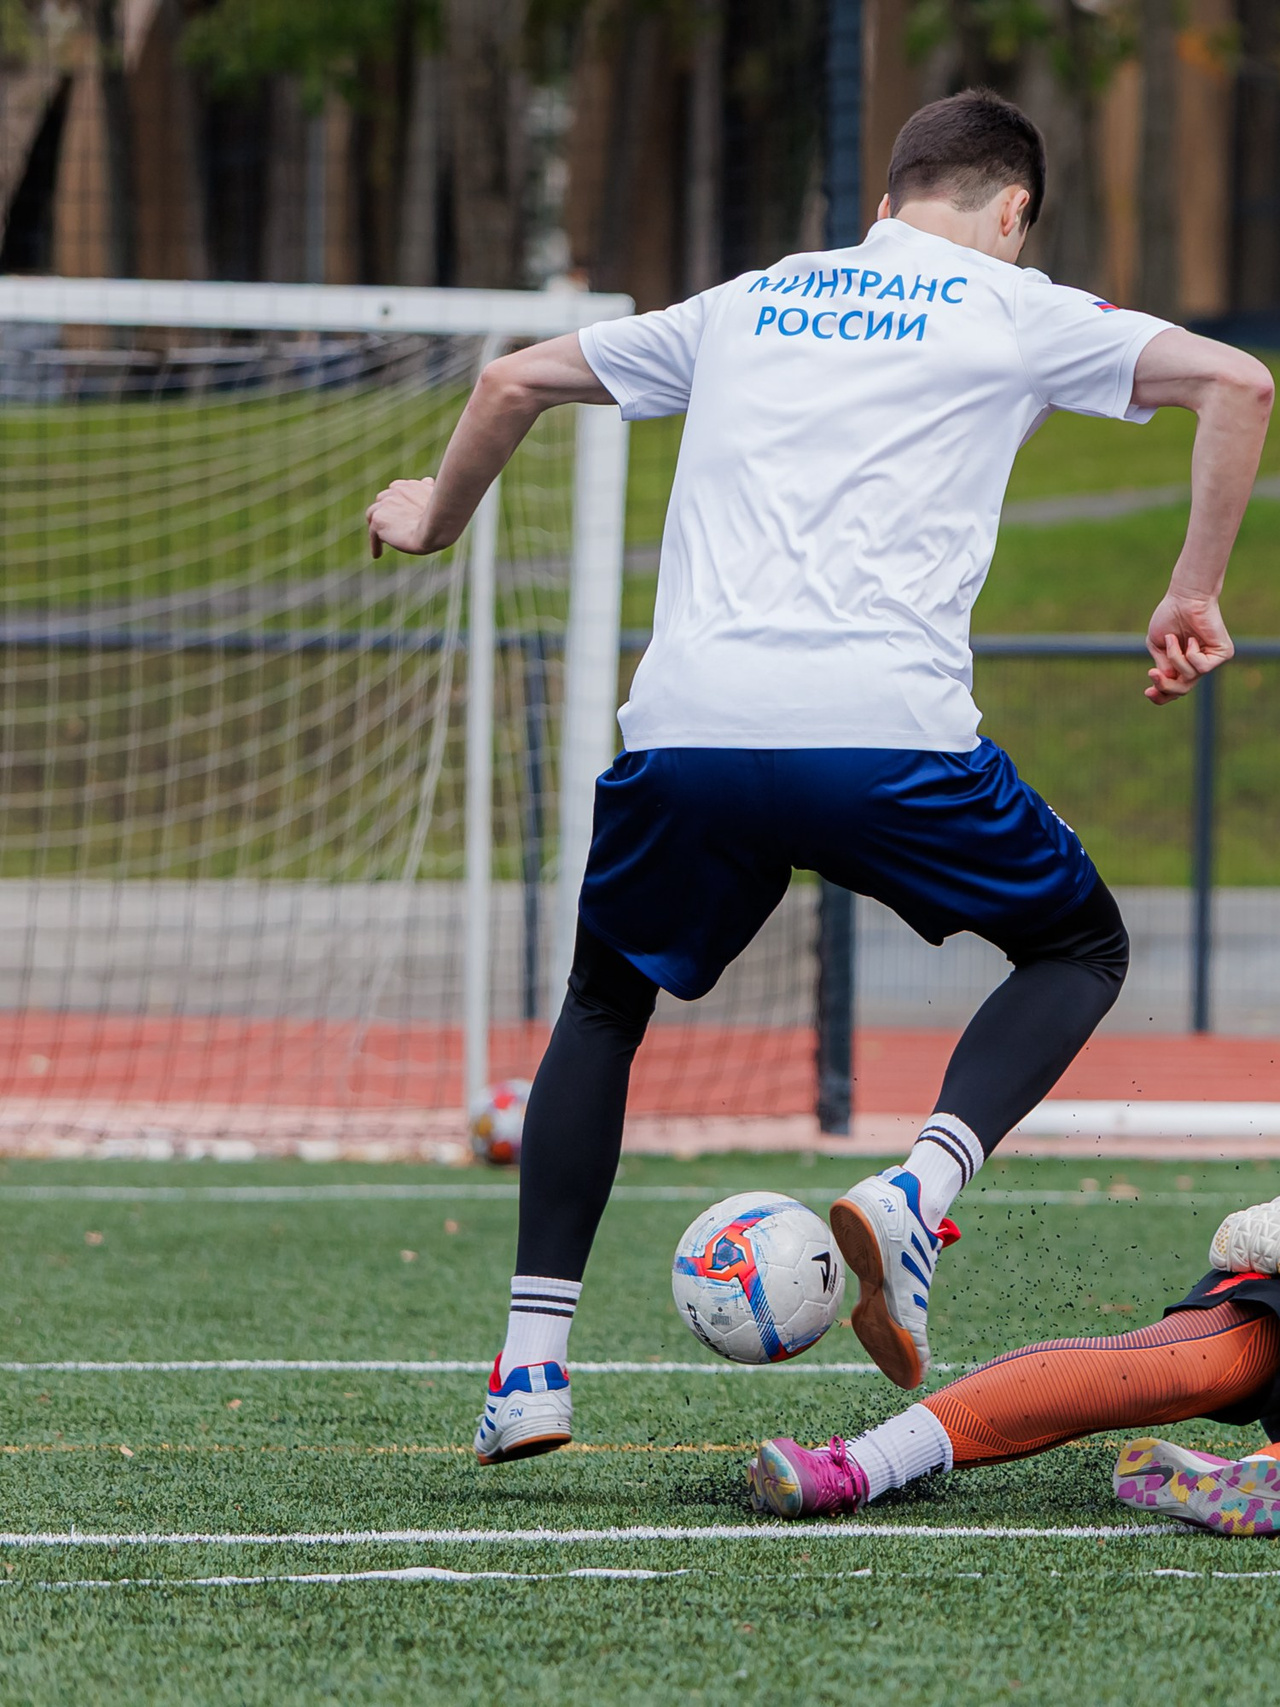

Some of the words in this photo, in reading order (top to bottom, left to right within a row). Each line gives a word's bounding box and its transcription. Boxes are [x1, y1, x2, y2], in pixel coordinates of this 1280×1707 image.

[747, 268, 968, 304] МИНТРАНС
[754, 305, 928, 342] РОССИИ
[686, 1301, 730, 1359] DEM
